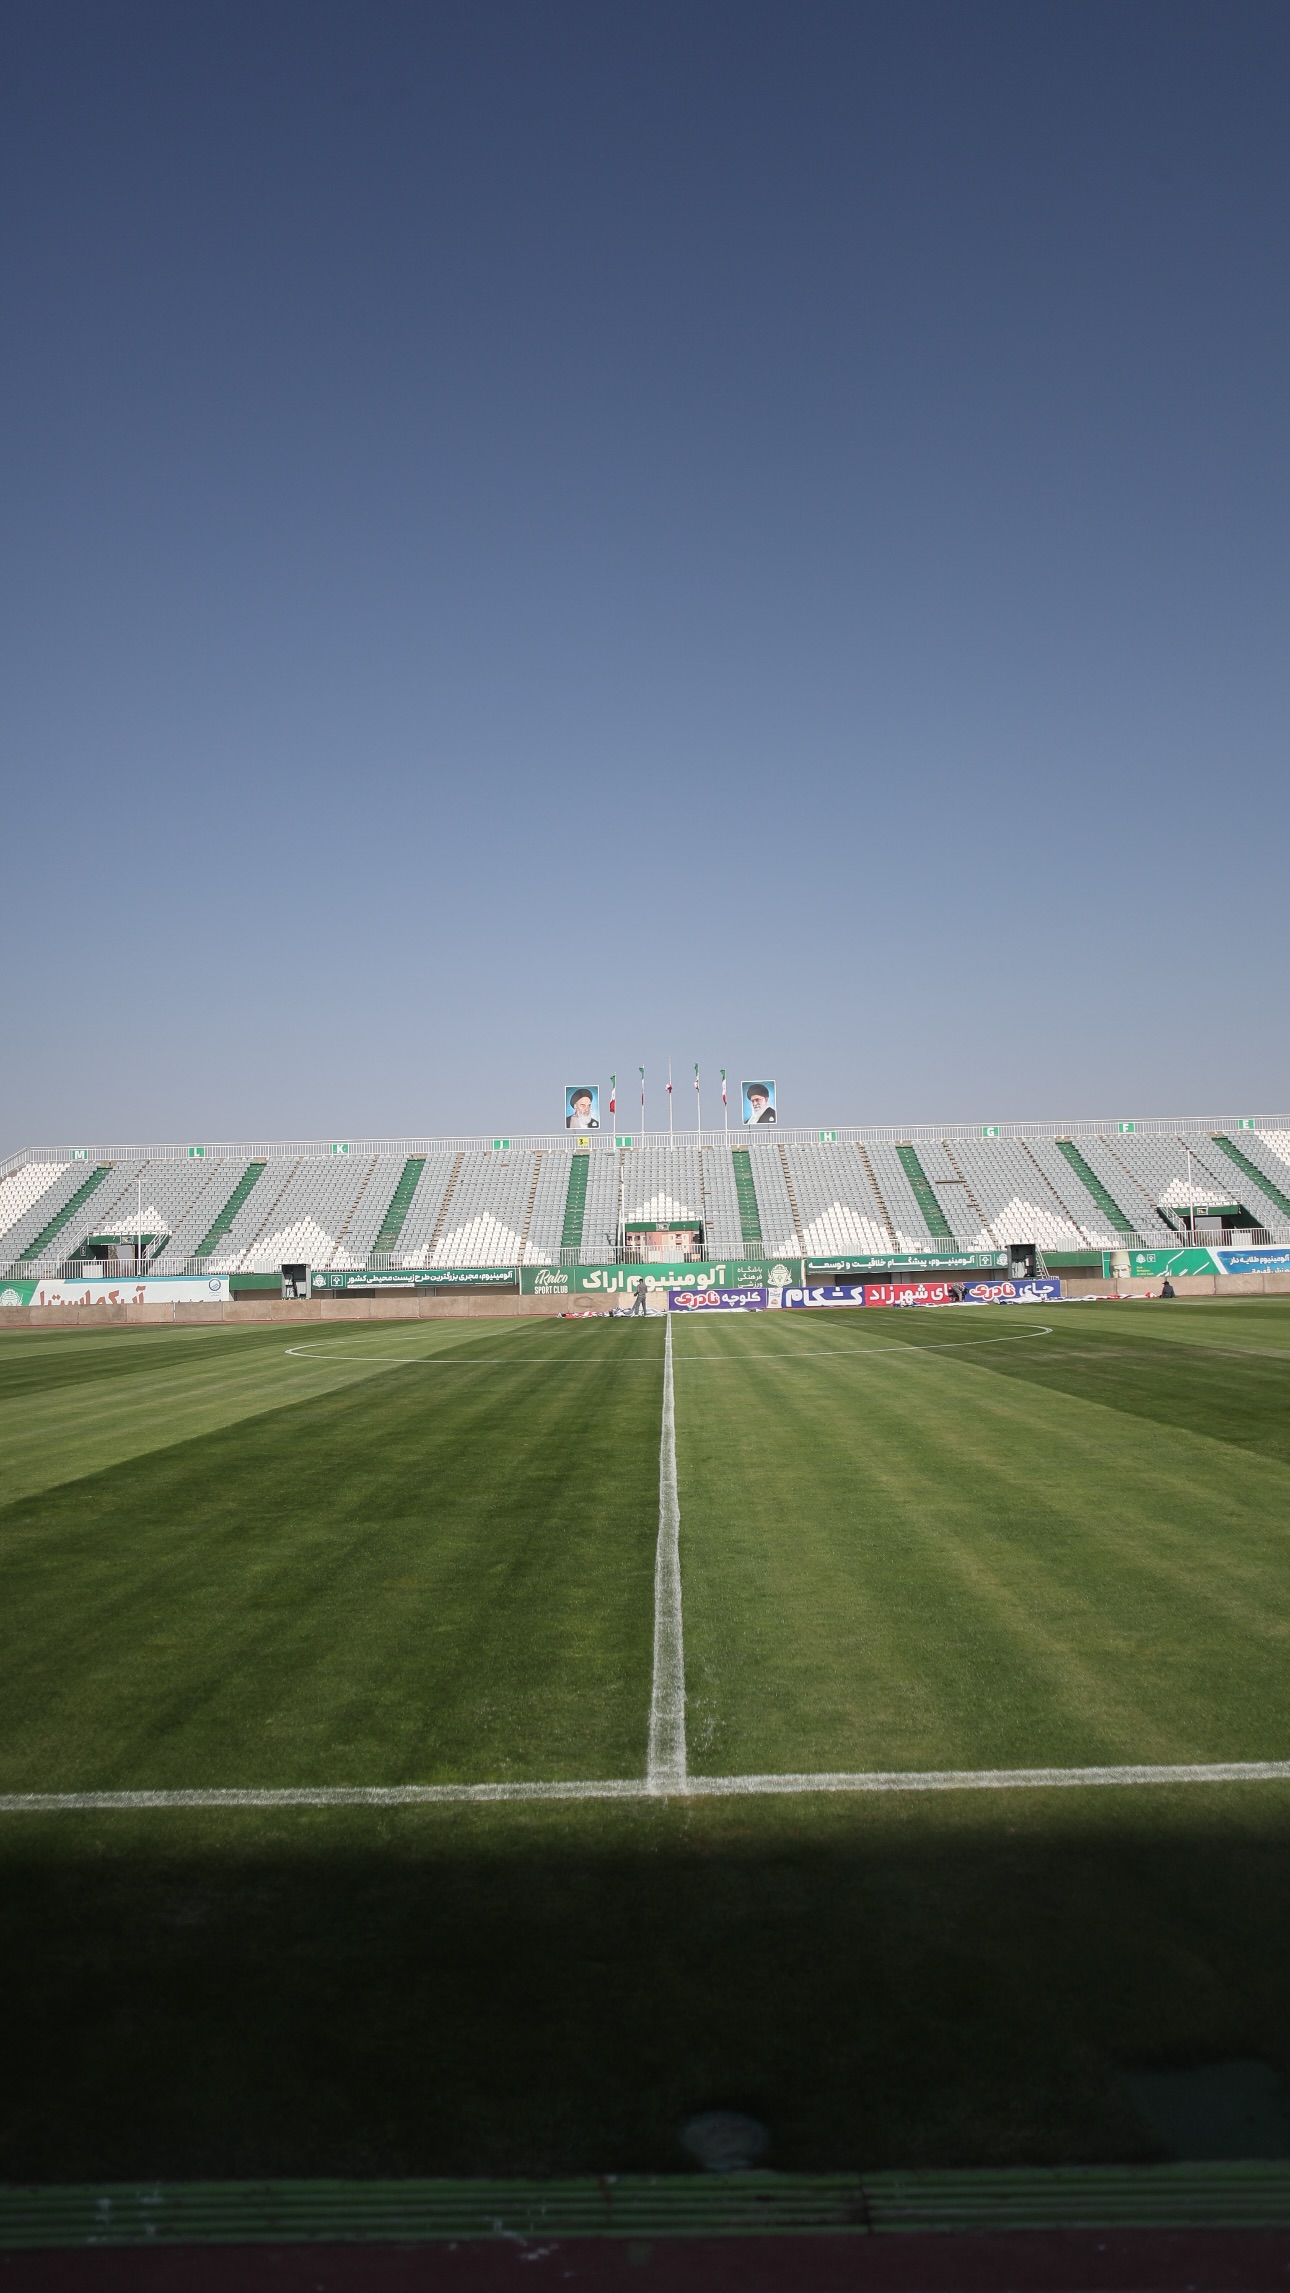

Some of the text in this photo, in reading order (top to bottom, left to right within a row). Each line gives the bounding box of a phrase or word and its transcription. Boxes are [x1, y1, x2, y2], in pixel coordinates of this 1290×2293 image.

[1122, 1124, 1129, 1133] F
[1243, 1119, 1249, 1128] E
[824, 1132, 832, 1141] H
[986, 1127, 994, 1136] G
[337, 1144, 345, 1153] K
[75, 1151, 85, 1160] M
[808, 1260, 845, 1270] توسعه
[845, 1261, 851, 1270] و
[851, 1258, 886, 1269] خلاقیت
[347, 1274, 367, 1284] کشور
[582, 1270, 624, 1293] اراک
[534, 1284, 569, 1295] SPORT CLUB
[869, 1284, 929, 1305] شهرزاد
[969, 1282, 1016, 1301] نادری
[673, 1290, 721, 1309] نادری
[721, 1291, 761, 1307] کلوچه
